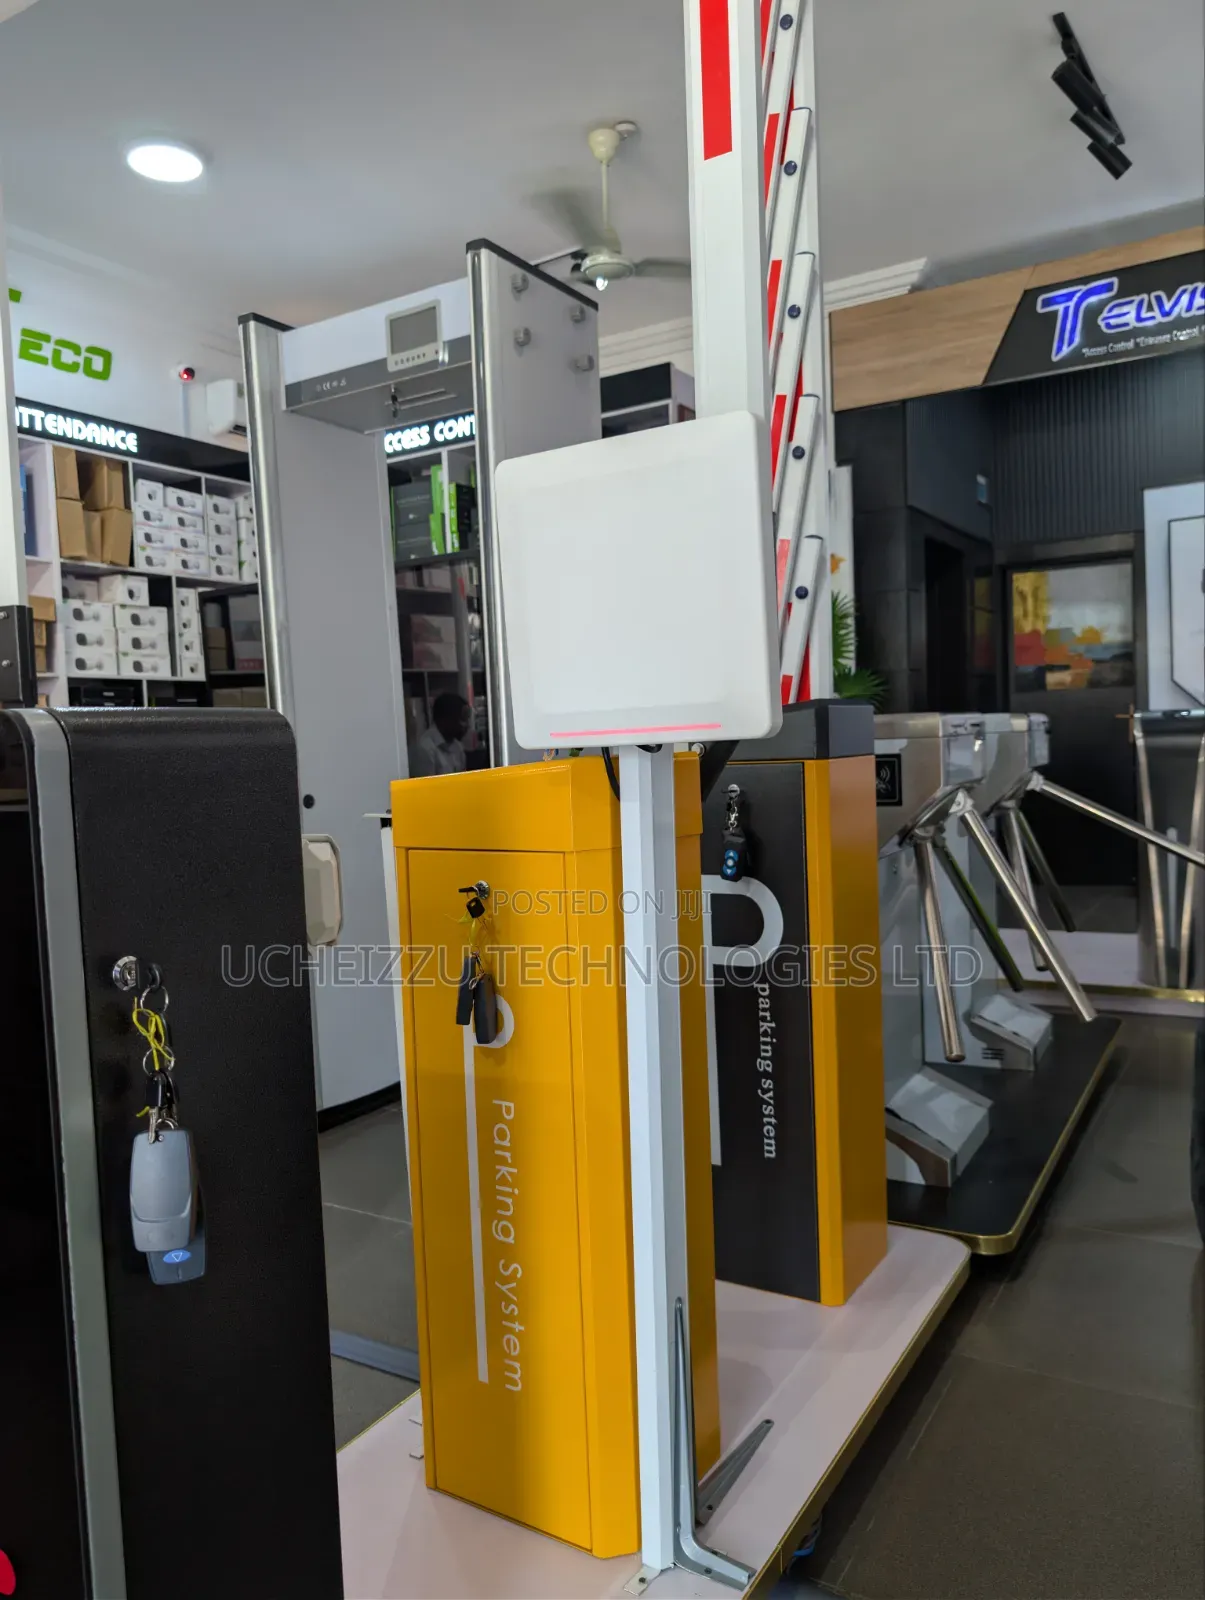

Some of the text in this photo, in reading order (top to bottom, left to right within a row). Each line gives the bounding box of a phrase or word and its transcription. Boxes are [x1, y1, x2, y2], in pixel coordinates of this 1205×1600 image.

[753, 981, 778, 1159] parking system
[492, 1099, 525, 1392] Parking System
